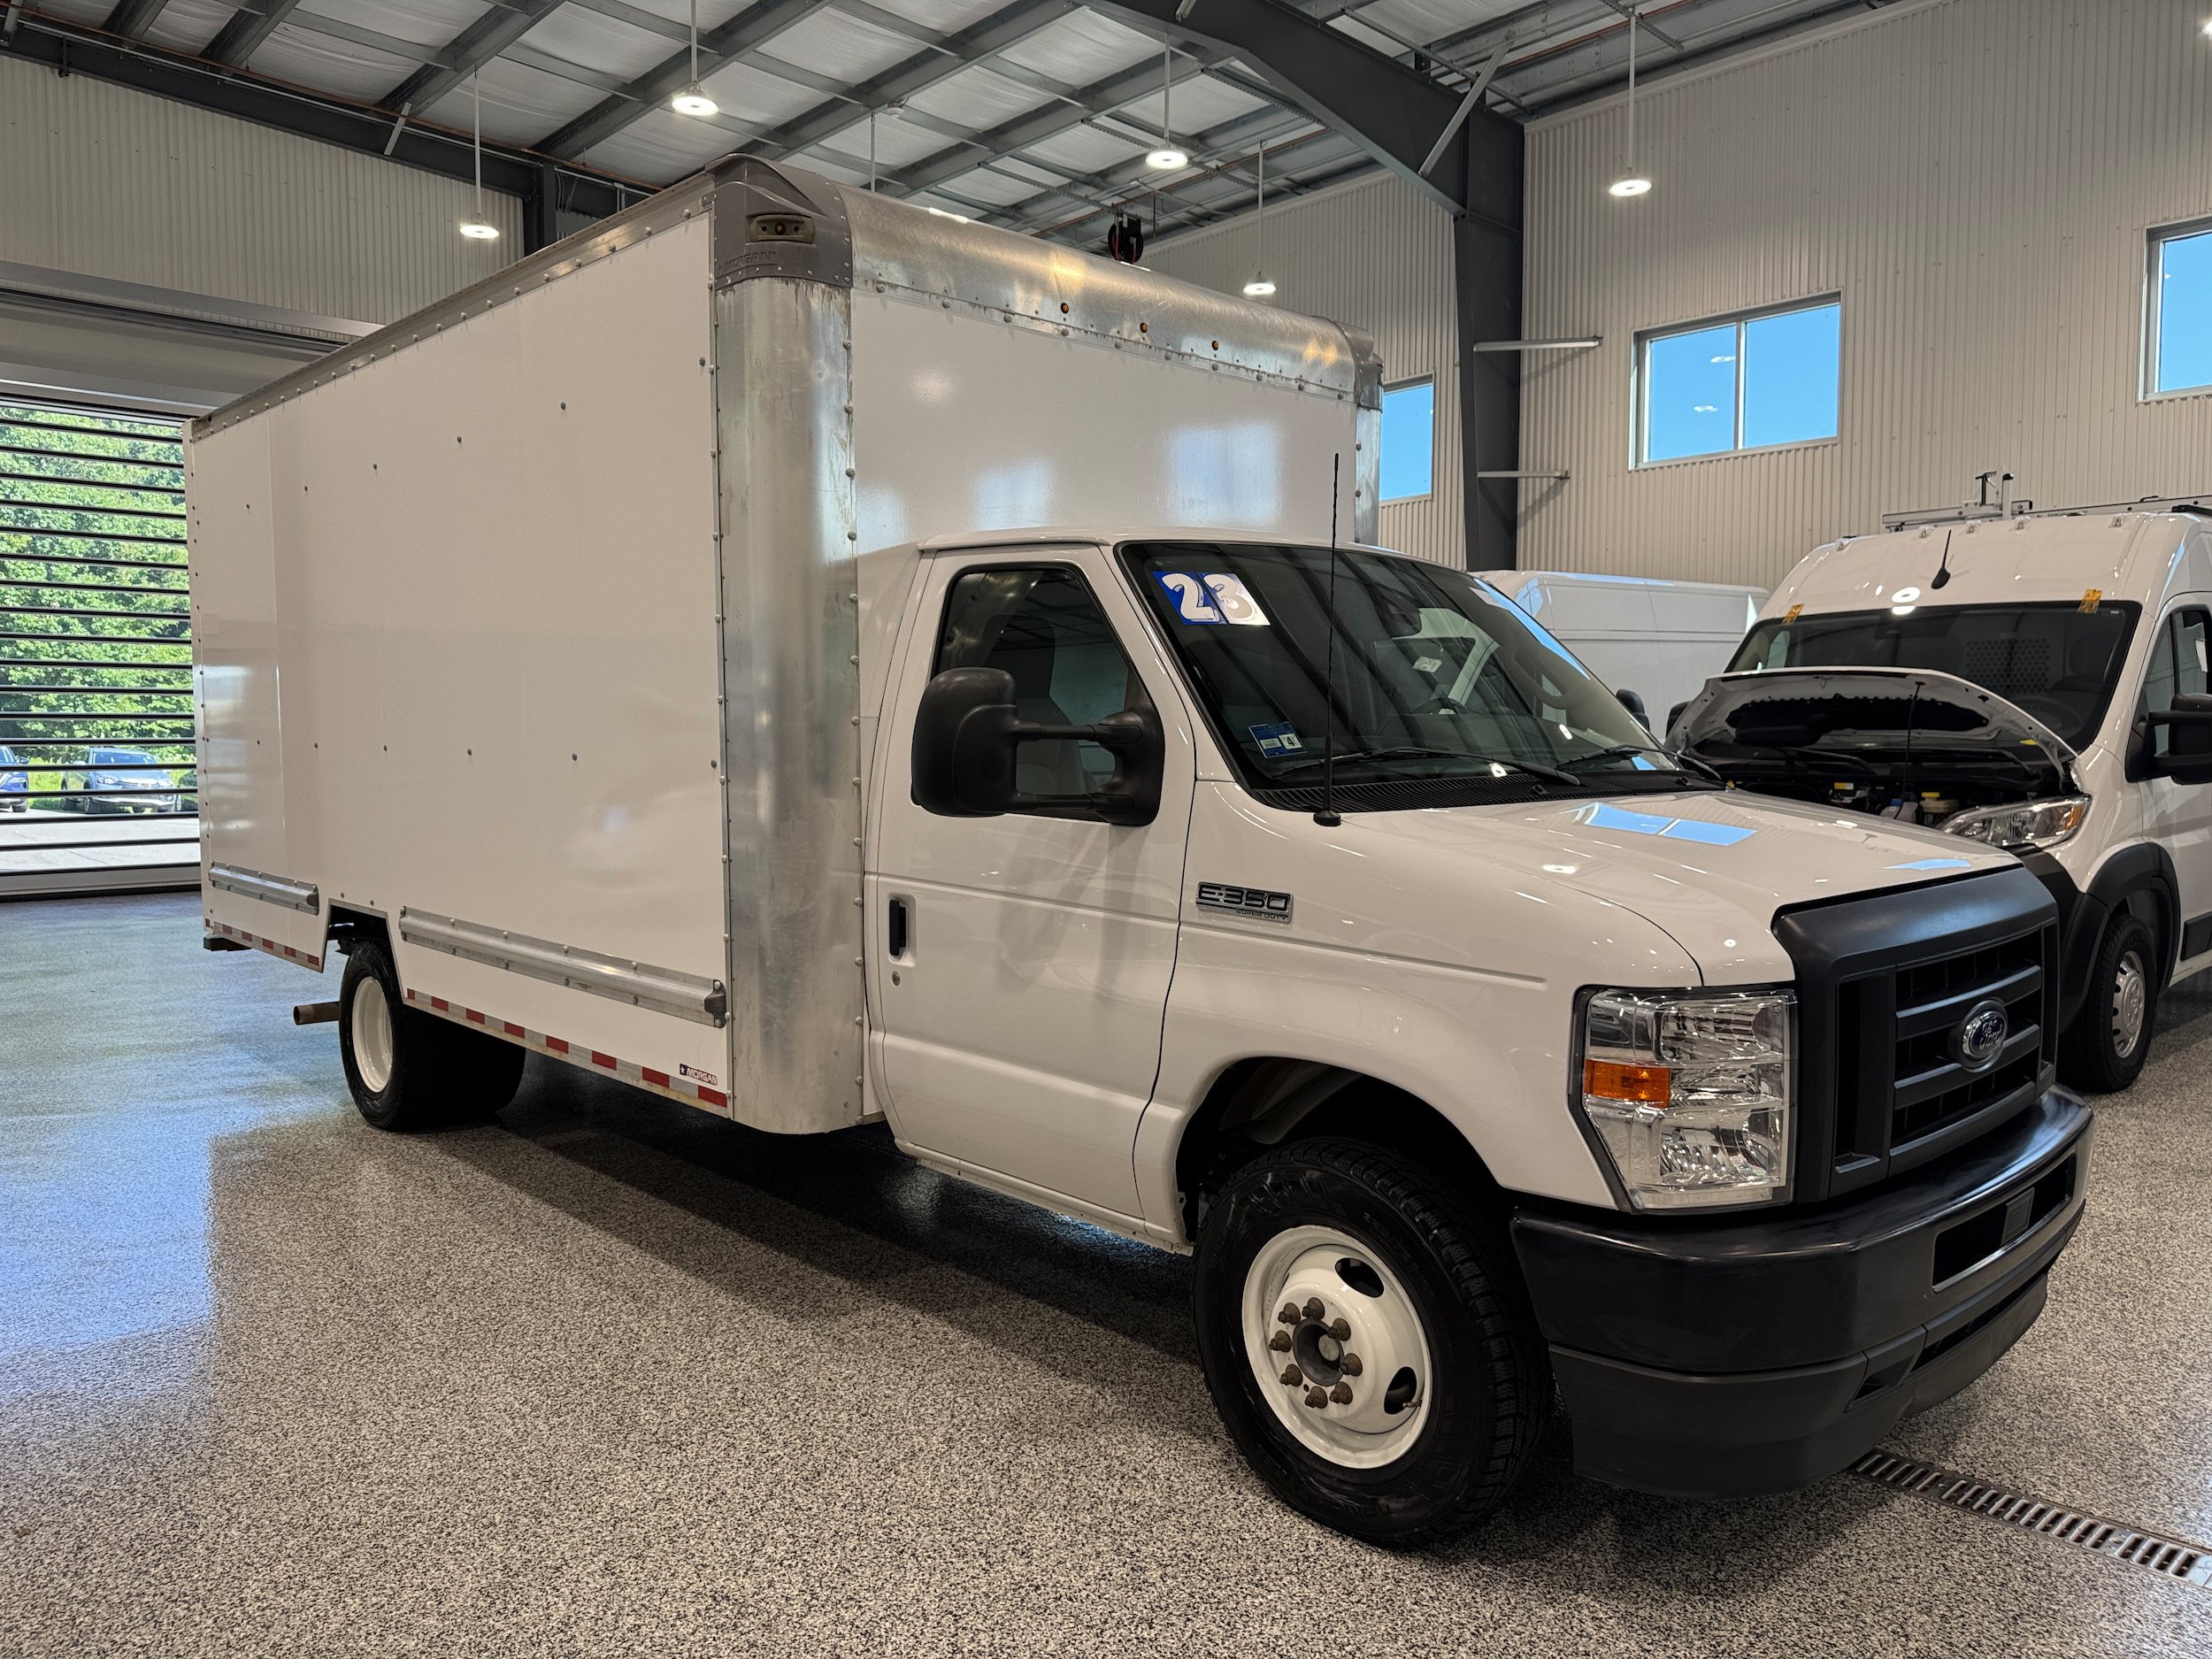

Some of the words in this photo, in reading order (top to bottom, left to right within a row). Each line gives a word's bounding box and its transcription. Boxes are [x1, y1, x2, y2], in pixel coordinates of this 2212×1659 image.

[1162, 572, 1253, 623] 23
[1198, 883, 1290, 912] E-350
[1979, 1018, 2002, 1051] Ford
[686, 1068, 718, 1086] MORGAN
